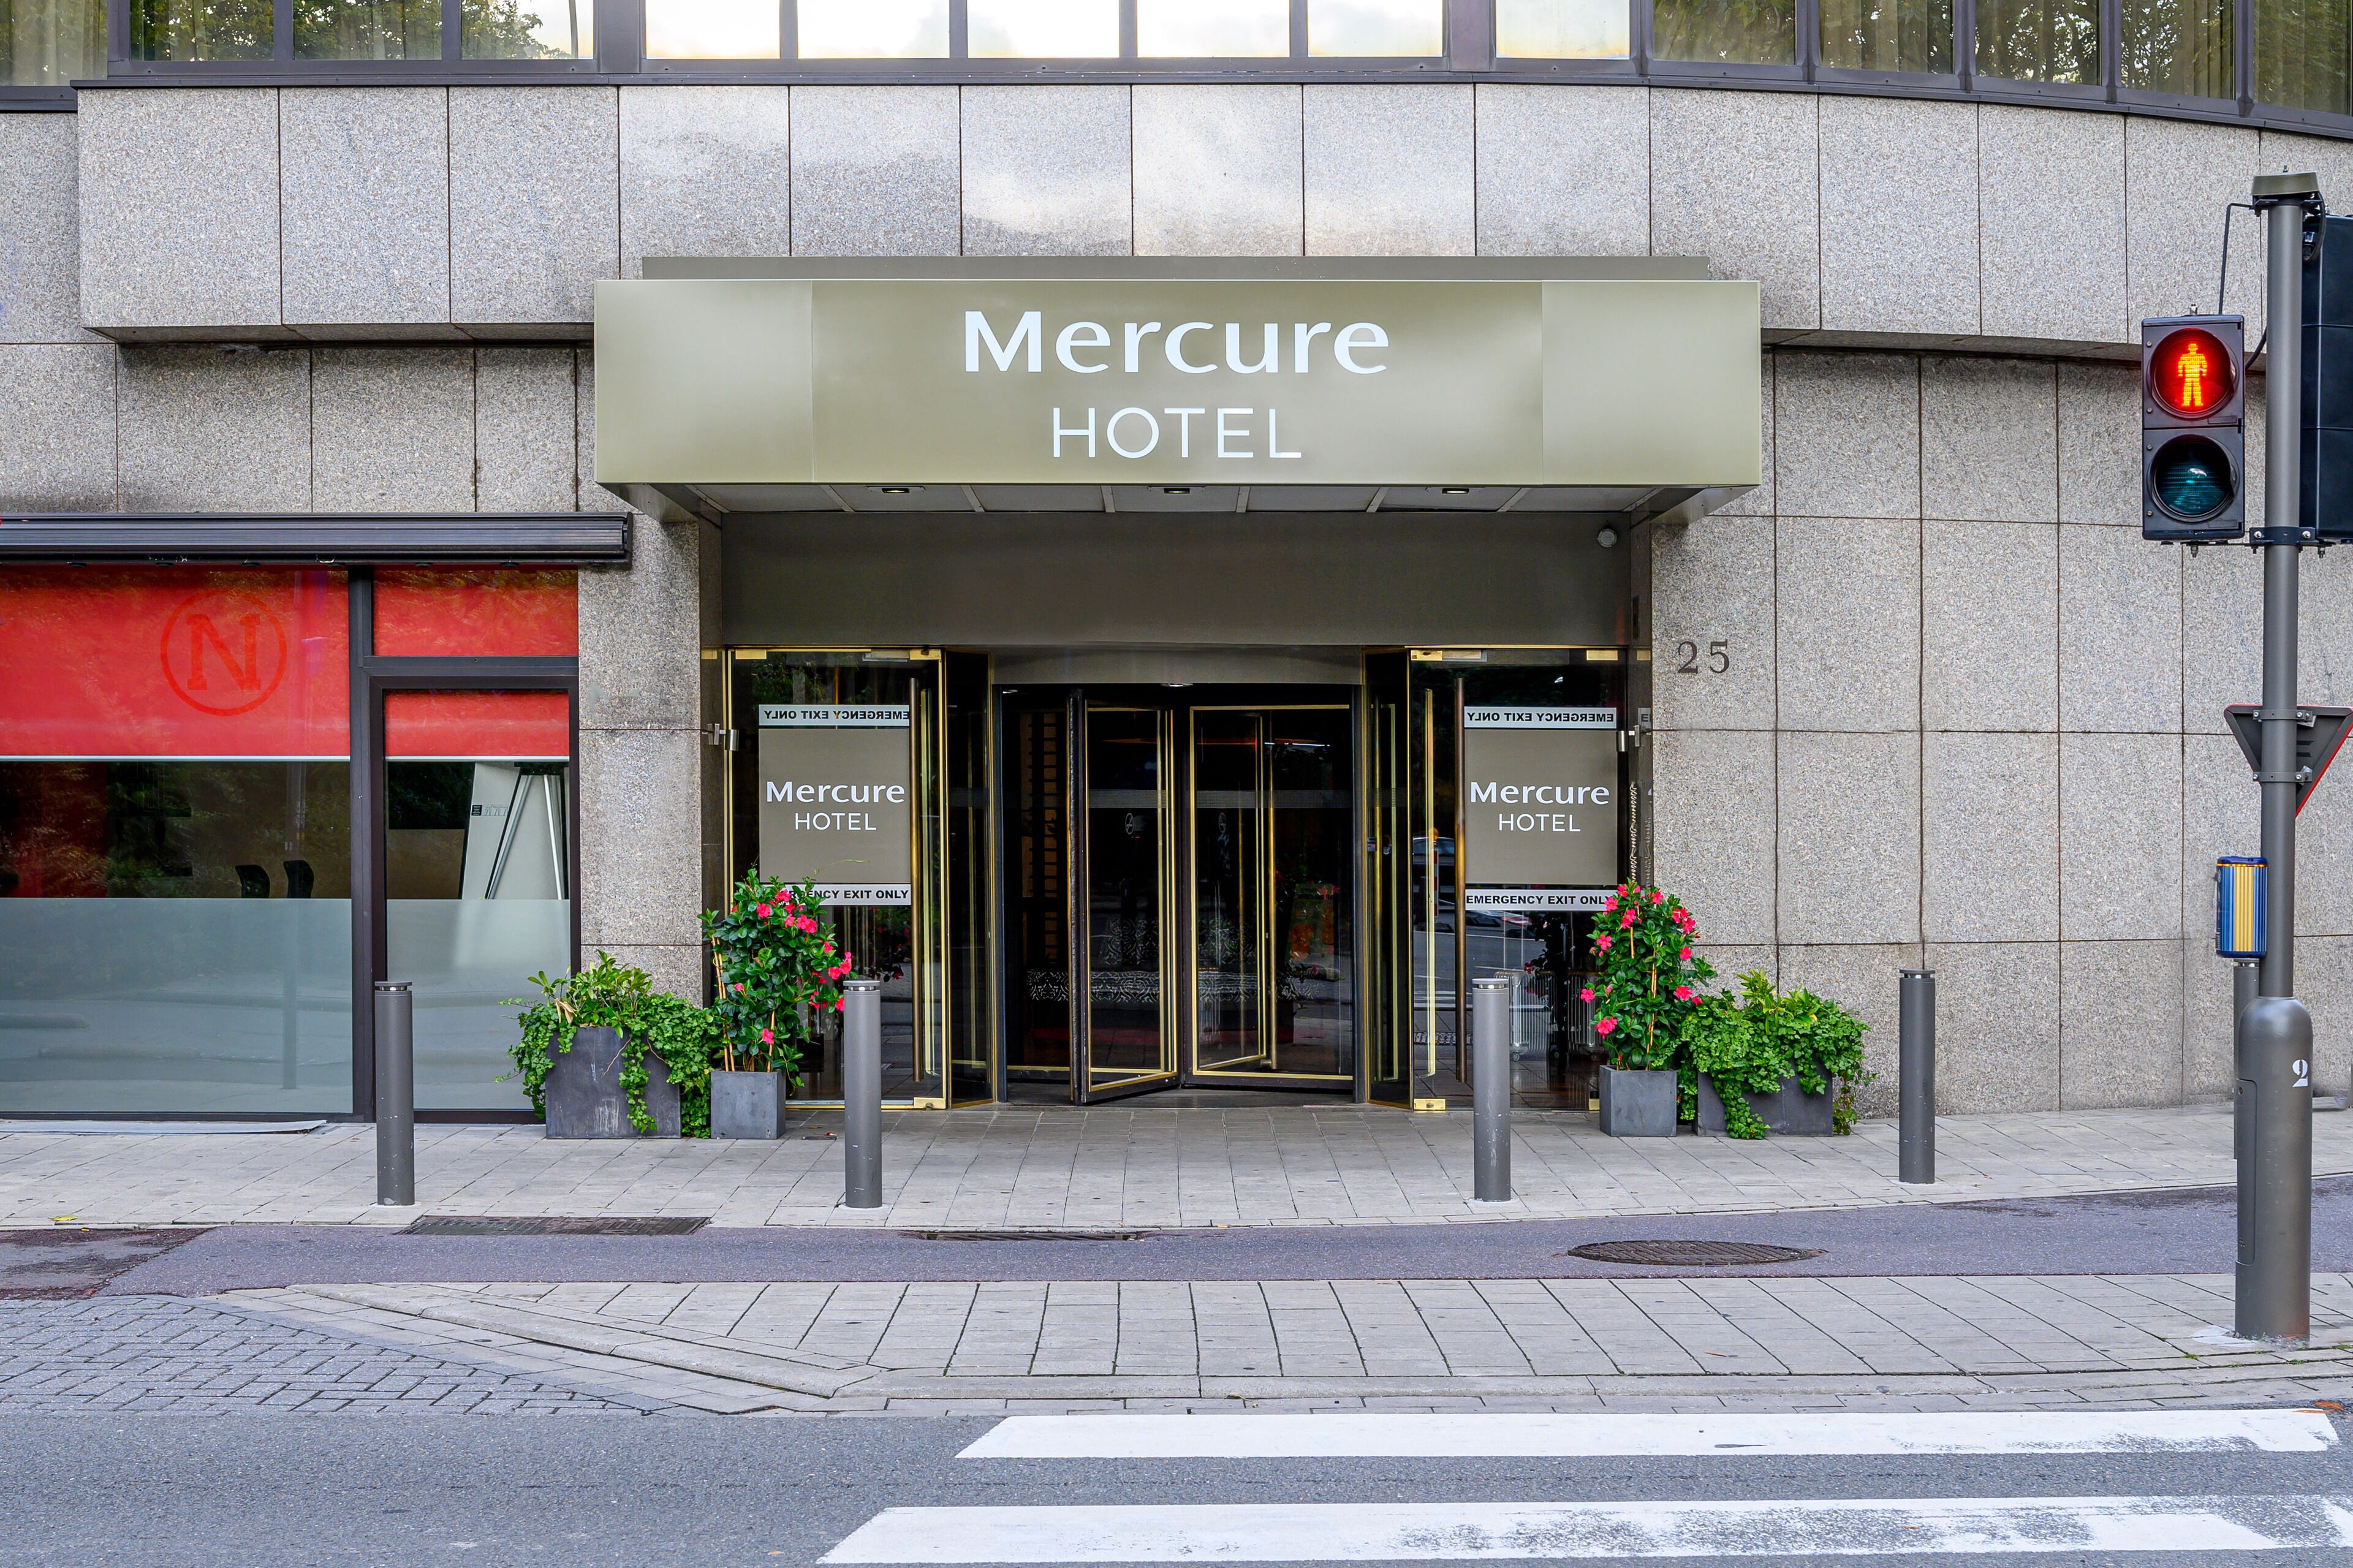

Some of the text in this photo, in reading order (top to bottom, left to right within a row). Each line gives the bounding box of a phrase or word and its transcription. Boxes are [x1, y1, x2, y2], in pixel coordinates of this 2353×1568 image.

[965, 311, 1389, 374] Mercure
[1053, 407, 1302, 458] HOTEL
[186, 613, 261, 691] N
[1678, 639, 1730, 674] 25
[767, 781, 905, 803] Mercure
[1471, 781, 1610, 805] Mercure
[795, 812, 877, 830] HOTEL
[1499, 813, 1581, 832] HOTEL
[843, 890, 872, 899] EXIT
[876, 890, 909, 899] ONLY
[1466, 895, 1544, 904] EMERGENCY
[1548, 895, 1576, 904] EXIT
